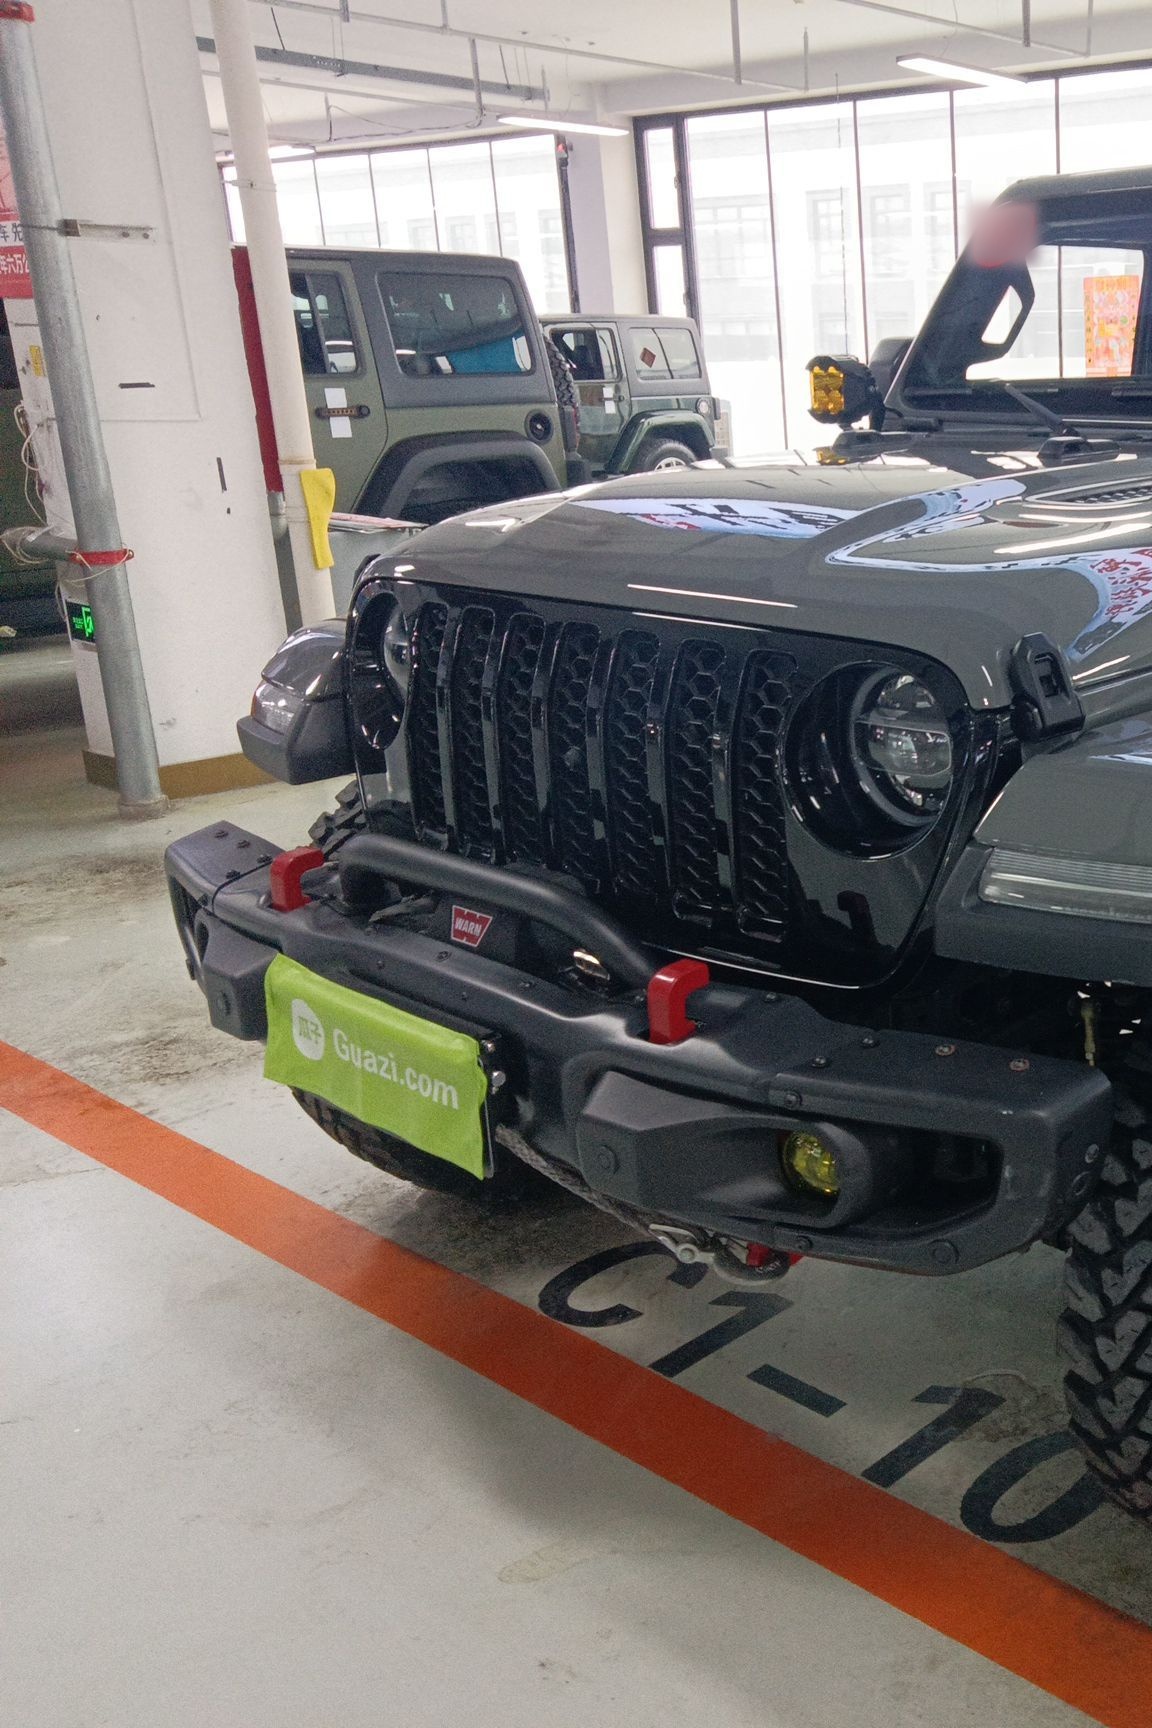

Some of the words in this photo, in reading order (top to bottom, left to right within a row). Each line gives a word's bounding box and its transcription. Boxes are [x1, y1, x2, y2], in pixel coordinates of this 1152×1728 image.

[455, 917, 482, 937] WARN
[298, 1015, 323, 1046] 瓜子
[333, 1028, 460, 1110] Guazi.com
